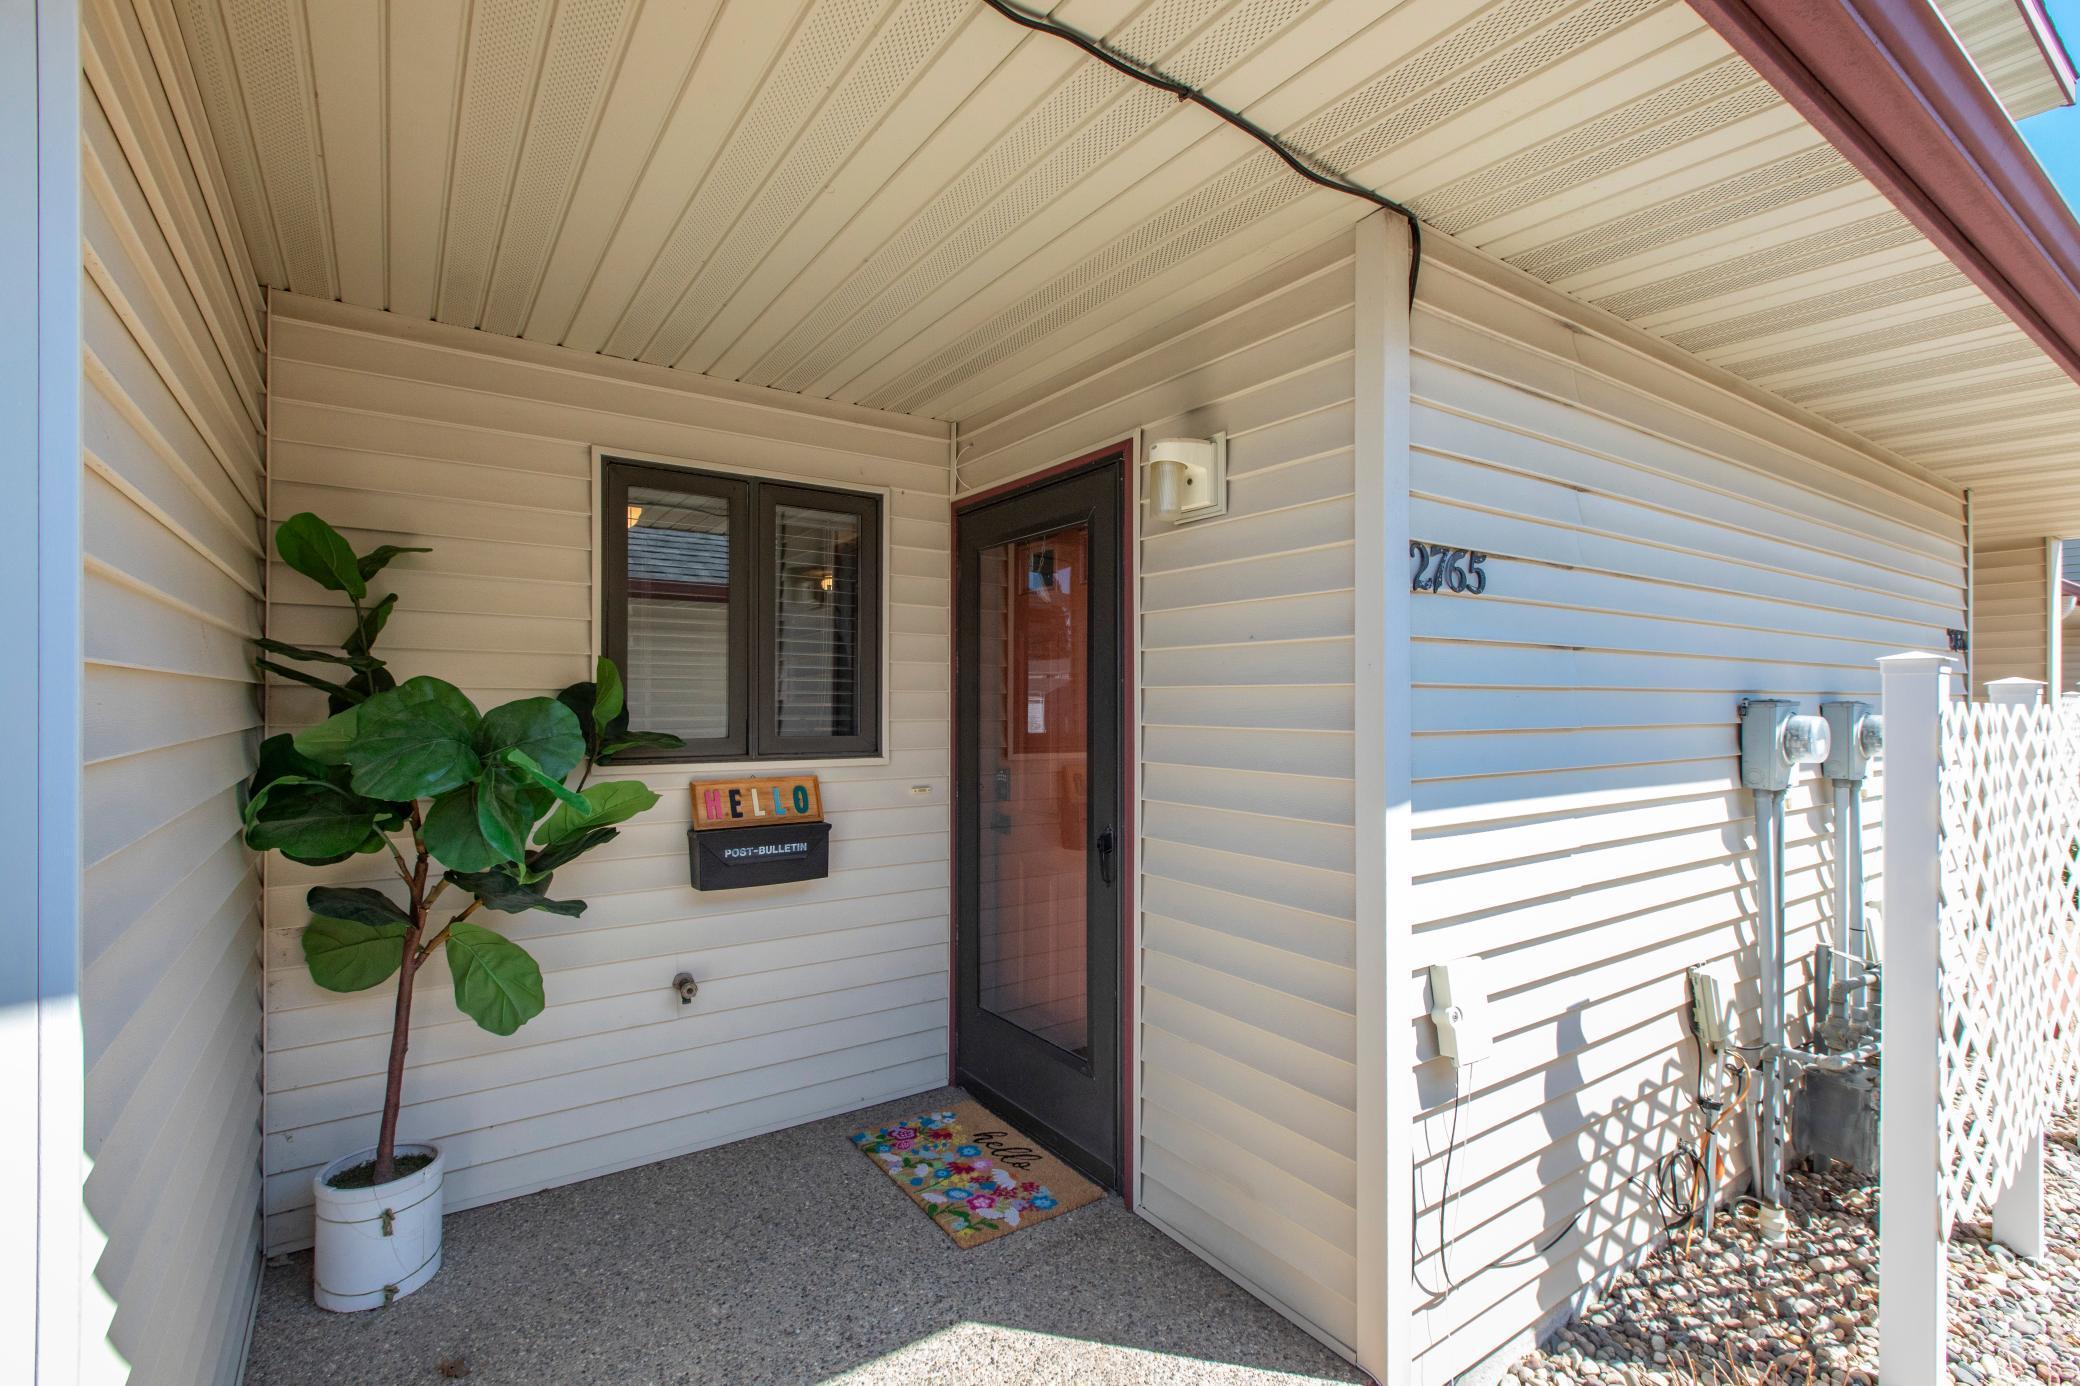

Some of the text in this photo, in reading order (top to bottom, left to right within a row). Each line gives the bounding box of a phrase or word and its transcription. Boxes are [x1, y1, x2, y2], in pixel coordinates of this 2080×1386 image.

[1409, 542, 1487, 594] 2765
[704, 785, 809, 819] HELLO
[724, 842, 808, 858] POST-BULLETIN
[973, 1131, 1043, 1171] hello
